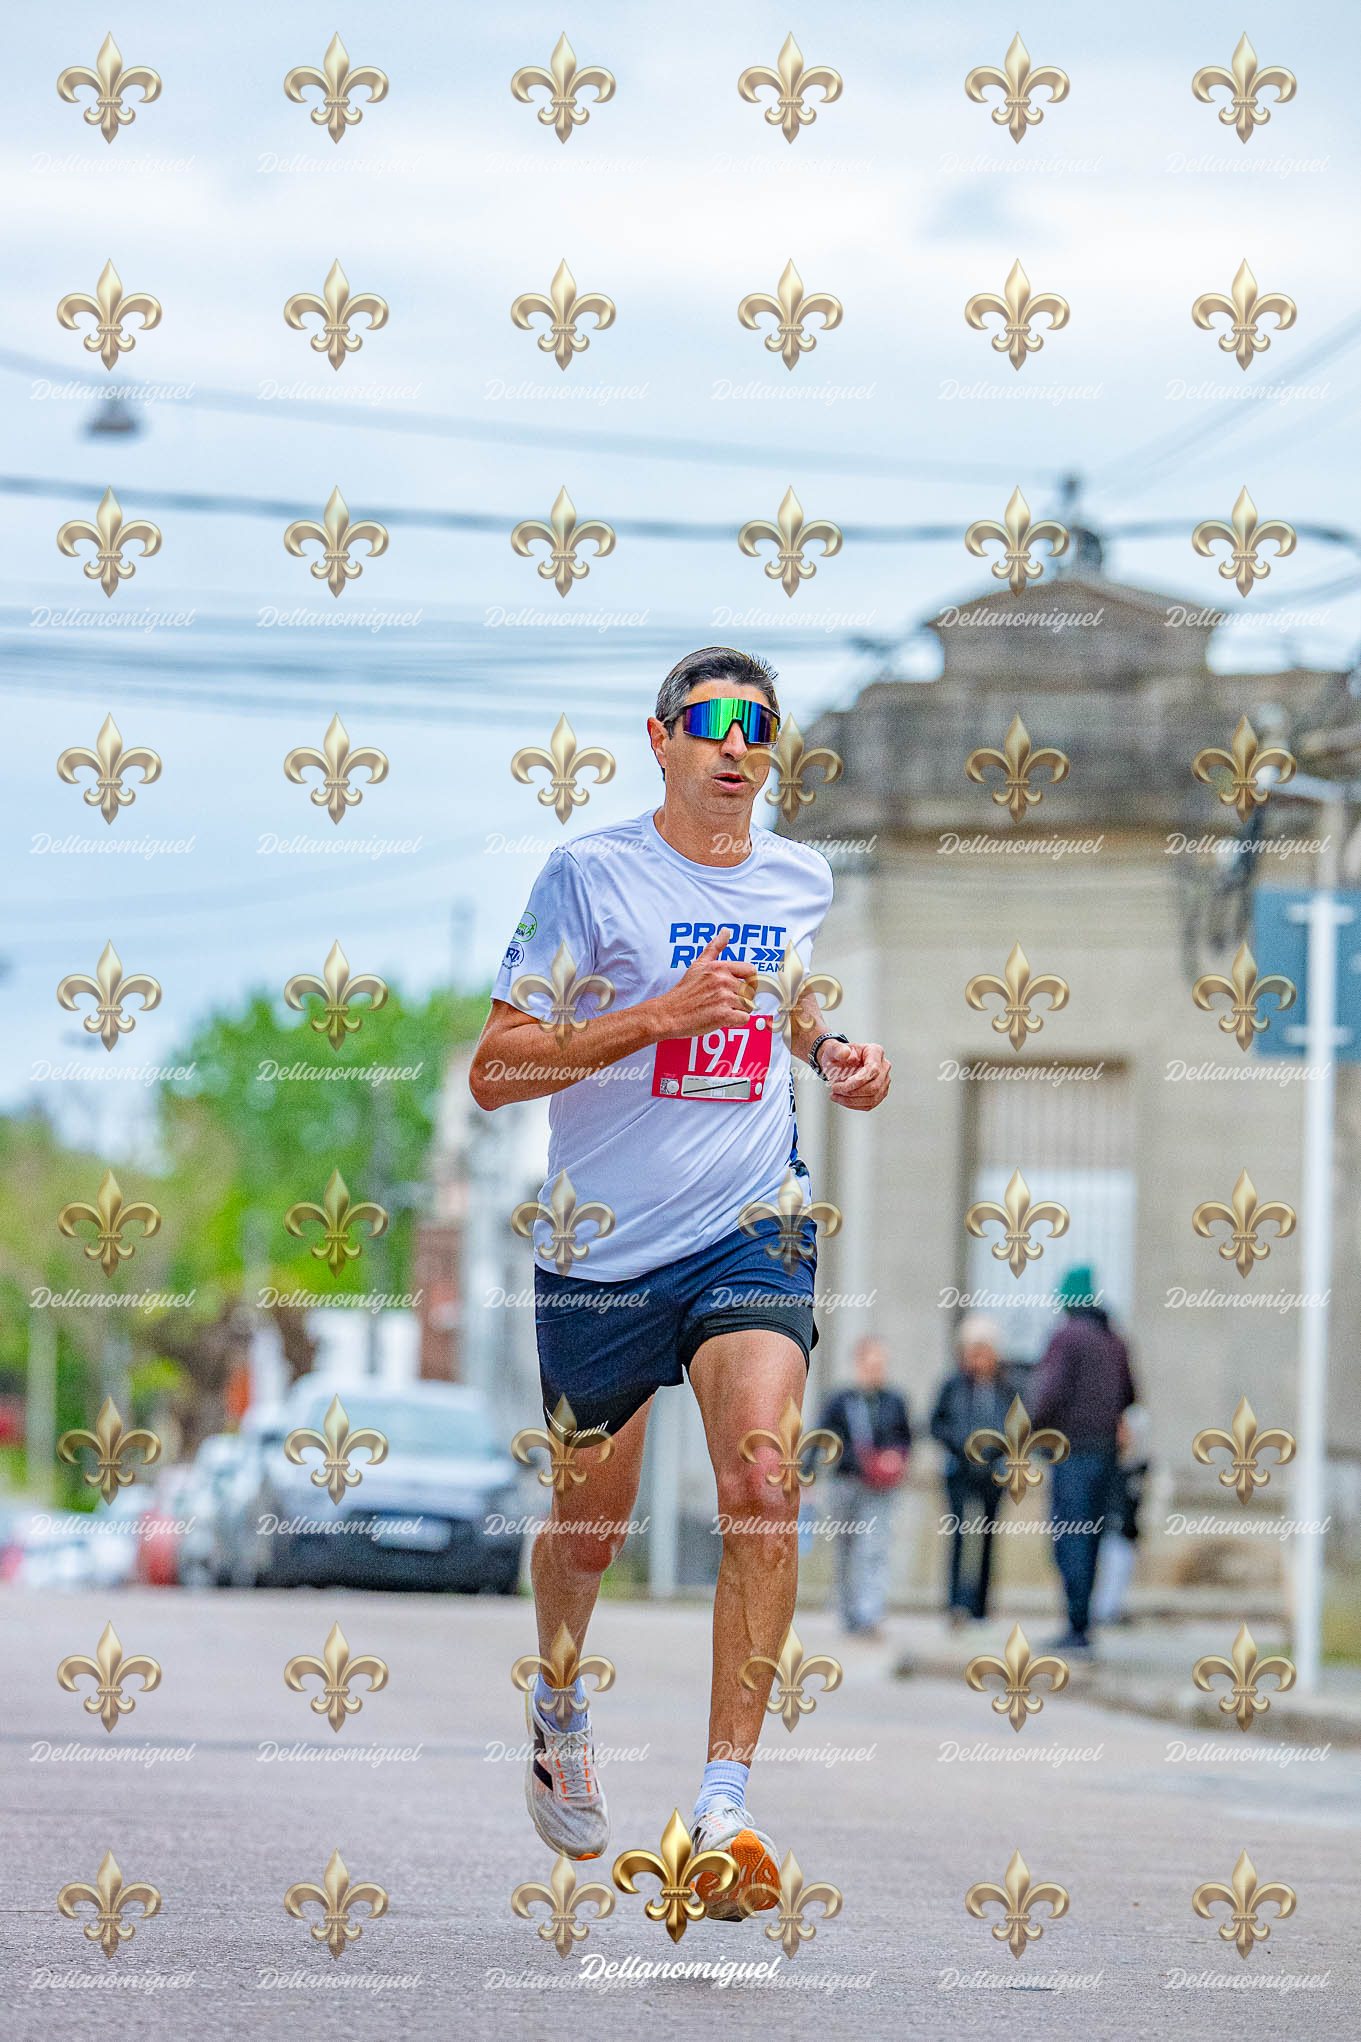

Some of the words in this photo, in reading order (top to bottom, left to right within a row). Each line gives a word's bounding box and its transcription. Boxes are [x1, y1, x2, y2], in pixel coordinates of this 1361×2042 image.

[669, 923, 786, 947] PROFIT
[670, 946, 746, 968] RN
[751, 962, 785, 973] TEAM
[688, 1028, 750, 1074] 197
